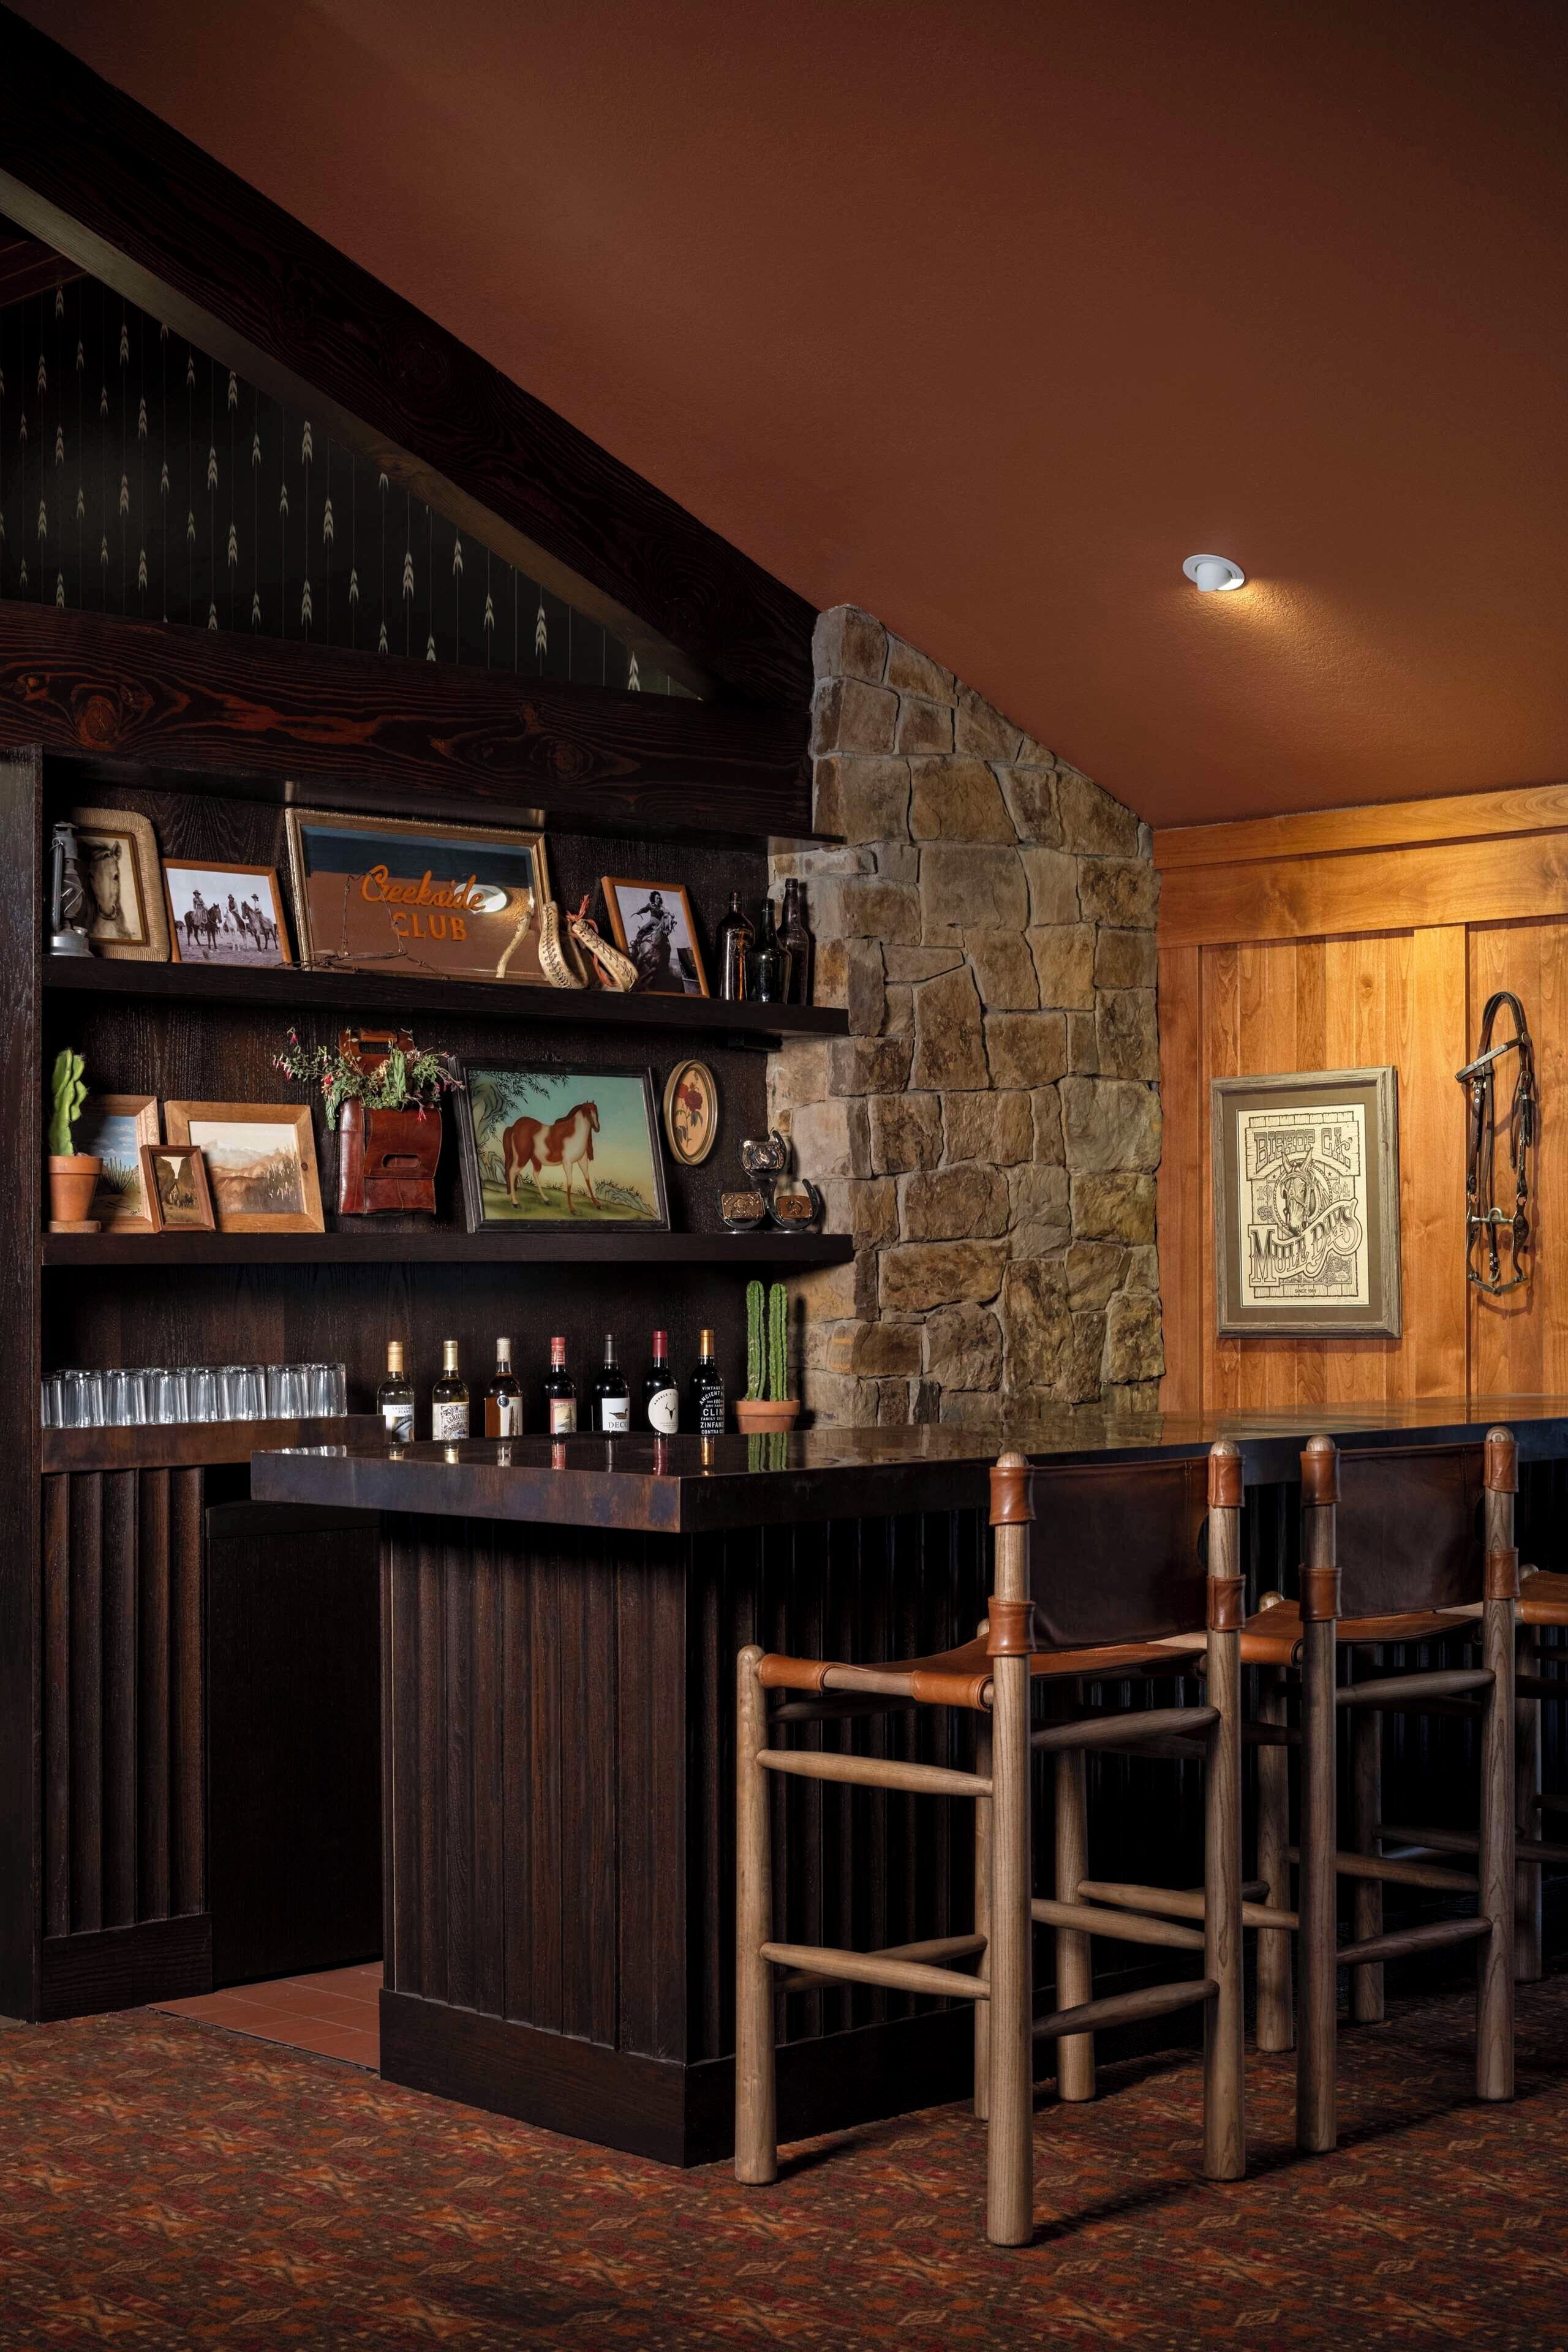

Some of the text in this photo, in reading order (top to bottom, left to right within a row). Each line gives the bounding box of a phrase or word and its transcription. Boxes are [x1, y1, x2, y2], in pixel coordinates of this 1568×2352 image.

[361, 864, 486, 911] Creekside
[392, 911, 467, 941] CLUB
[1254, 1129, 1315, 1174] BISHOP
[1251, 1201, 1358, 1283] MULE DAYS
[699, 1390, 720, 1405] ANCIENT
